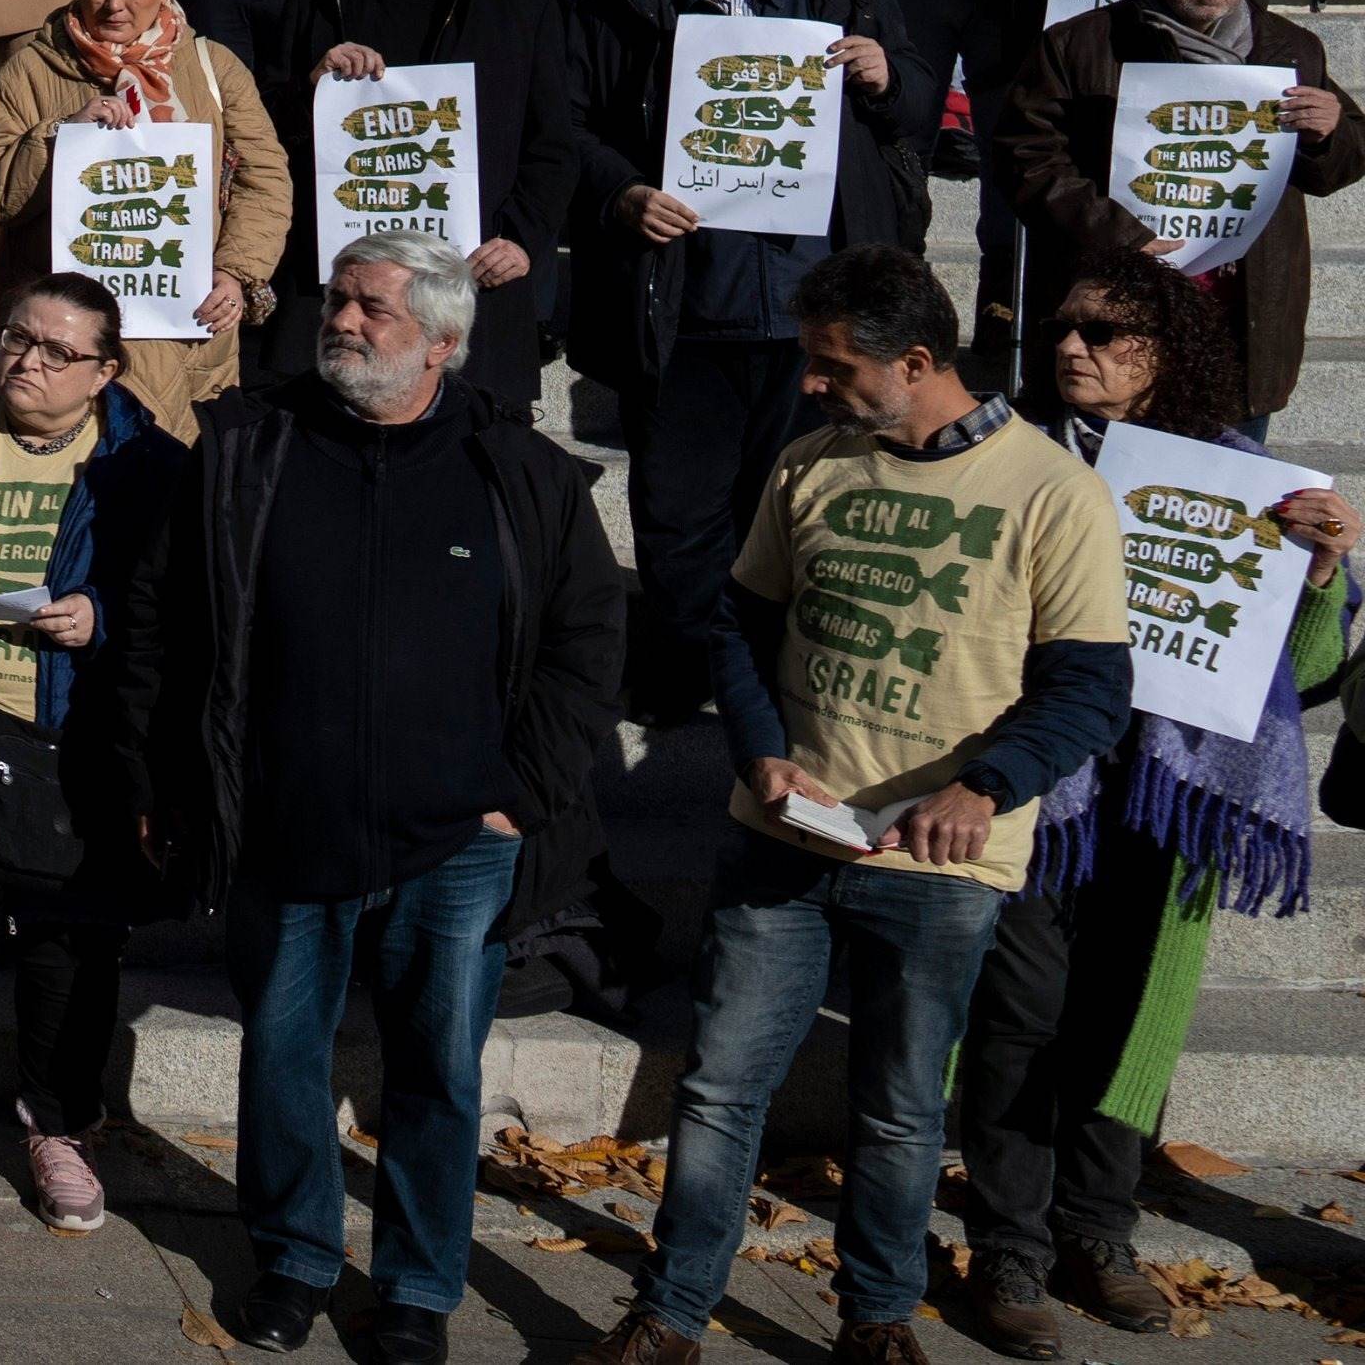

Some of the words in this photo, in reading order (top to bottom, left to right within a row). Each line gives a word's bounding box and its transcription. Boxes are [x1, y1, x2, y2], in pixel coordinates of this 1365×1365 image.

[364, 108, 413, 135] END
[1172, 106, 1228, 131] END
[356, 158, 372, 168] THE
[375, 152, 422, 172] ARMS
[1157, 151, 1175, 161] THE
[1178, 150, 1231, 167] ARMS
[101, 163, 151, 189] END
[357, 187, 409, 205] TRADE
[772, 179, 800, 198] مع
[1155, 182, 1213, 202] TRADE
[92, 211, 108, 221] THE
[110, 208, 156, 227] ARMS
[1159, 214, 1244, 238] ISRAEL
[92, 242, 144, 260] TRADE
[40, 495, 59, 510] AL
[846, 499, 901, 535] FIN
[908, 509, 931, 531] AL
[1125, 540, 1214, 575] COMERÇ
[814, 561, 914, 595] COMERCIO
[820, 615, 880, 648] ARMAS
[806, 653, 922, 720] ISRAEL
